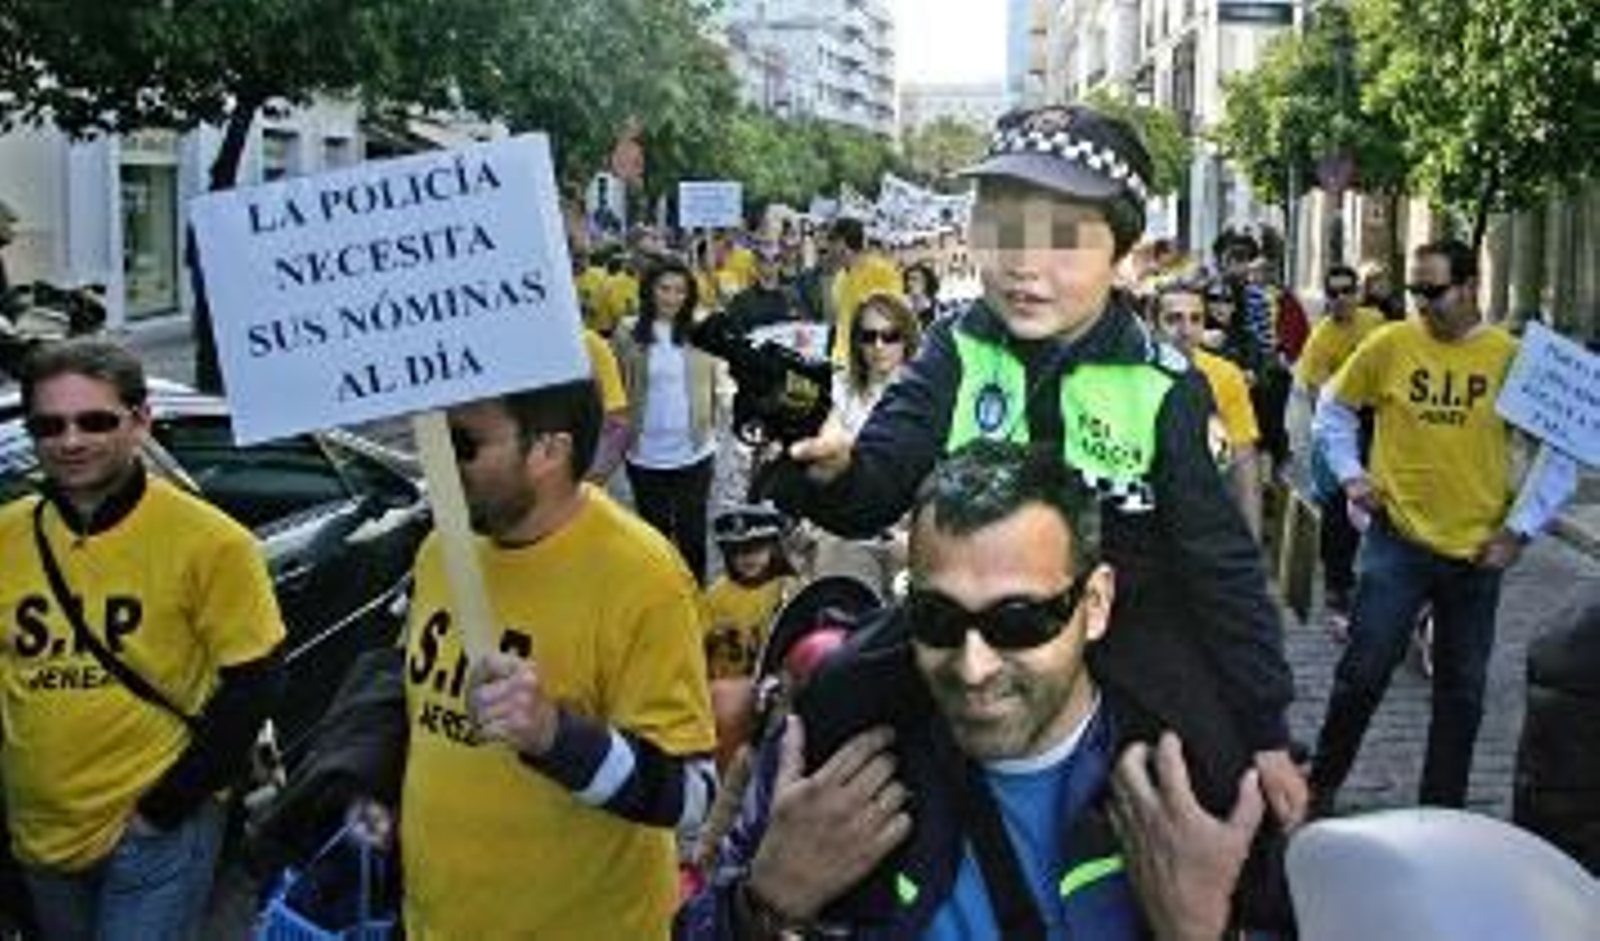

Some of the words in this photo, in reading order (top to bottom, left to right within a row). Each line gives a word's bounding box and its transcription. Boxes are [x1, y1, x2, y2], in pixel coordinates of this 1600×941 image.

[247, 202, 306, 234] LA
[320, 158, 501, 223] POLICÍA
[274, 225, 496, 290] NECESITA
[248, 319, 327, 357] SUS
[341, 269, 548, 341] NÓMINAS
[338, 364, 397, 402] AL
[406, 342, 484, 386] DÍA
